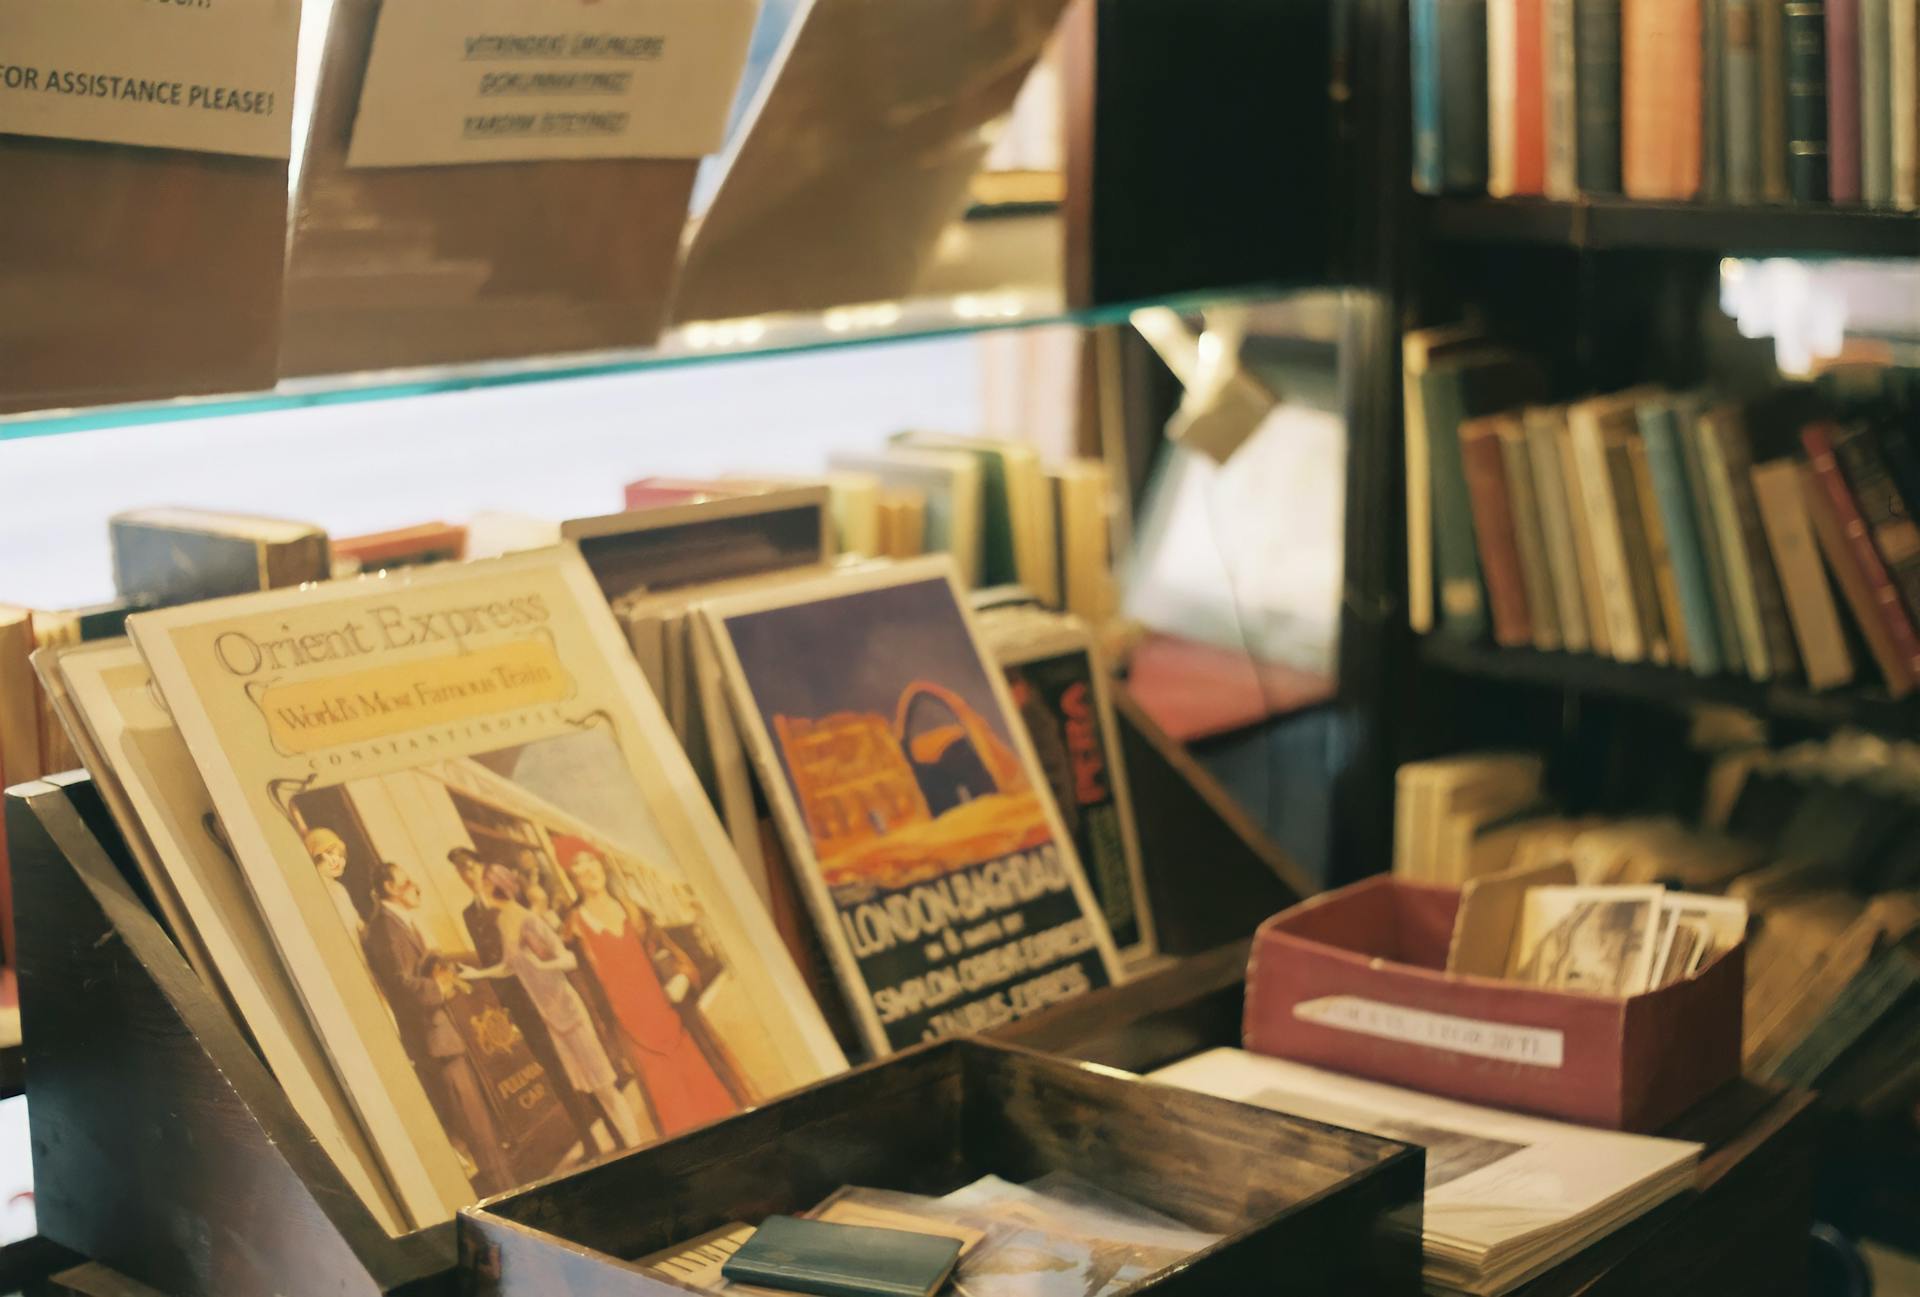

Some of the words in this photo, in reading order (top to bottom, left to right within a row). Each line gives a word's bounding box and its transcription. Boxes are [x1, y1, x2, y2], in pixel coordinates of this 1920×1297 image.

[45, 70, 183, 106] ASSISTANCE
[188, 84, 275, 117] PLEASE!
[213, 622, 374, 677] Orient
[366, 592, 551, 657] Express
[414, 681, 496, 708] Famous
[497, 662, 553, 688] Train
